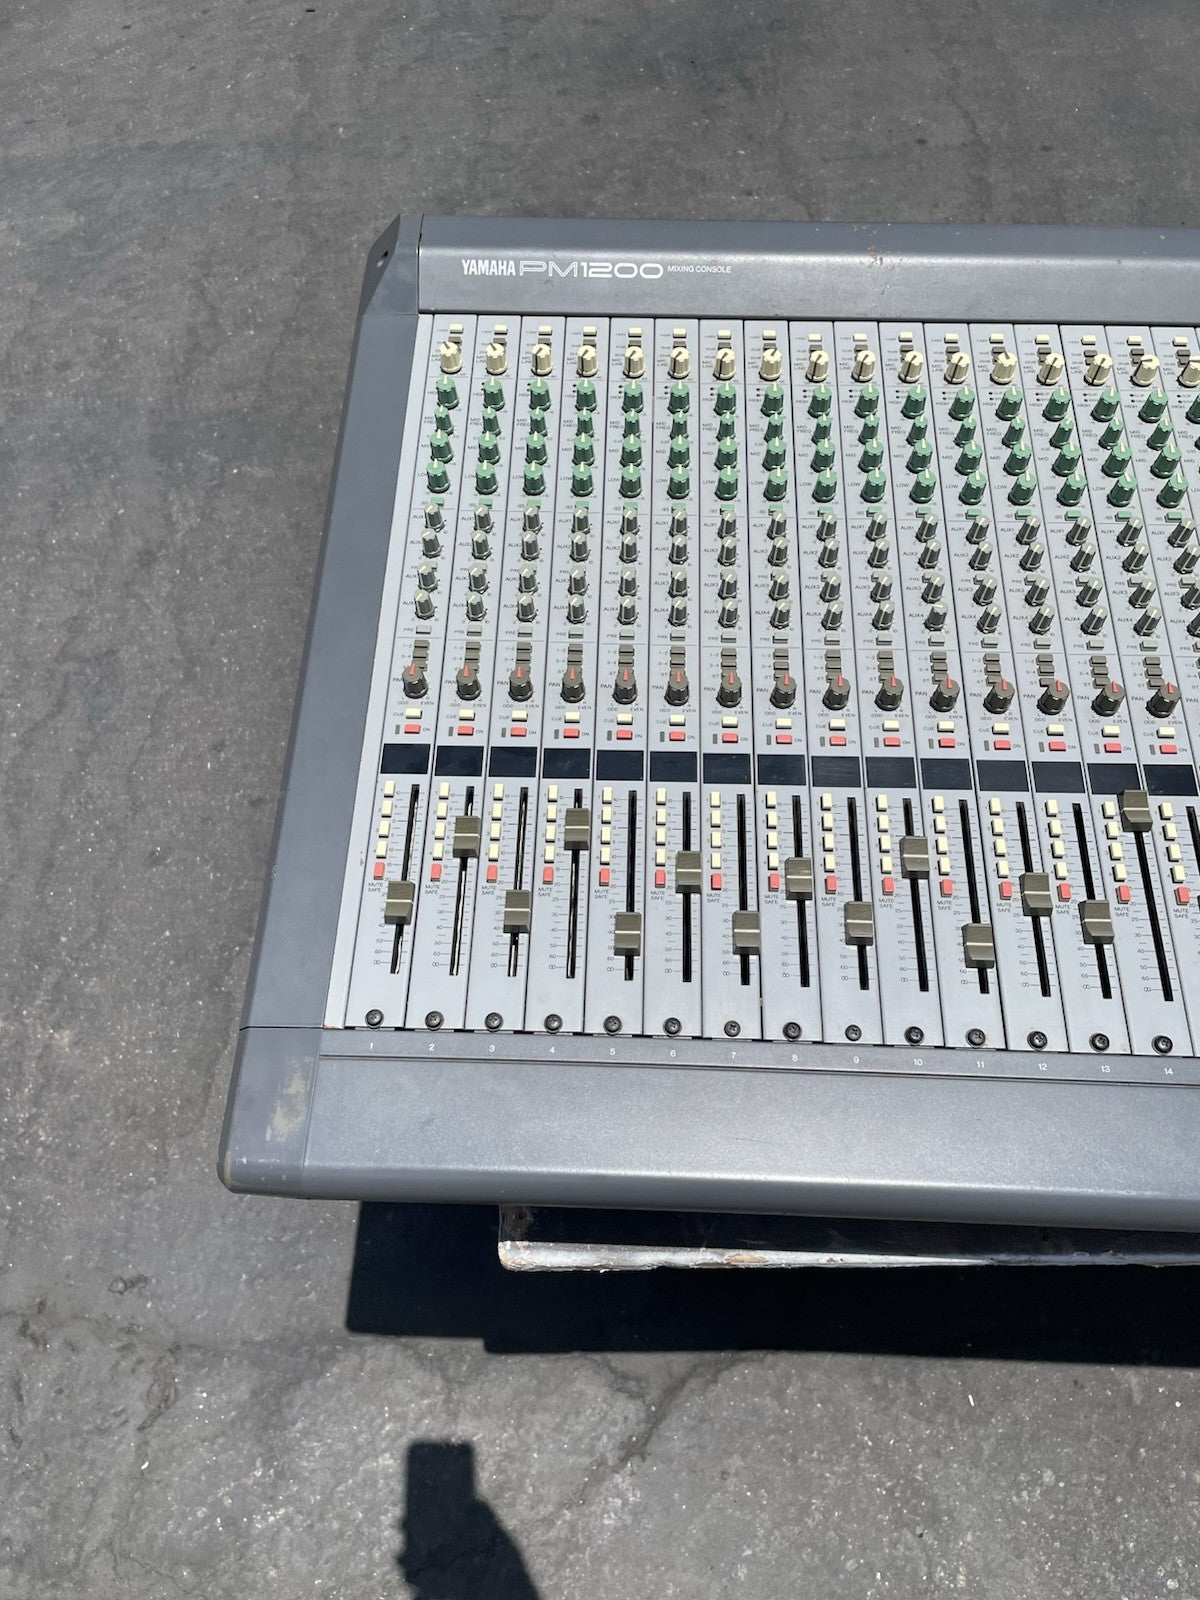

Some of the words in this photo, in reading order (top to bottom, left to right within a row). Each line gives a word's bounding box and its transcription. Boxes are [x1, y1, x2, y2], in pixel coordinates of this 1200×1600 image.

[462, 259, 516, 276] YAMAHA
[520, 260, 664, 279] PM1200
[695, 266, 732, 274] CONSOLE
[488, 1044, 494, 1052] 3
[610, 1048, 616, 1056] 5
[670, 1050, 676, 1058] 6
[792, 1054, 798, 1062] 8
[914, 1058, 922, 1066] 10
[1038, 1062, 1048, 1070] 12
